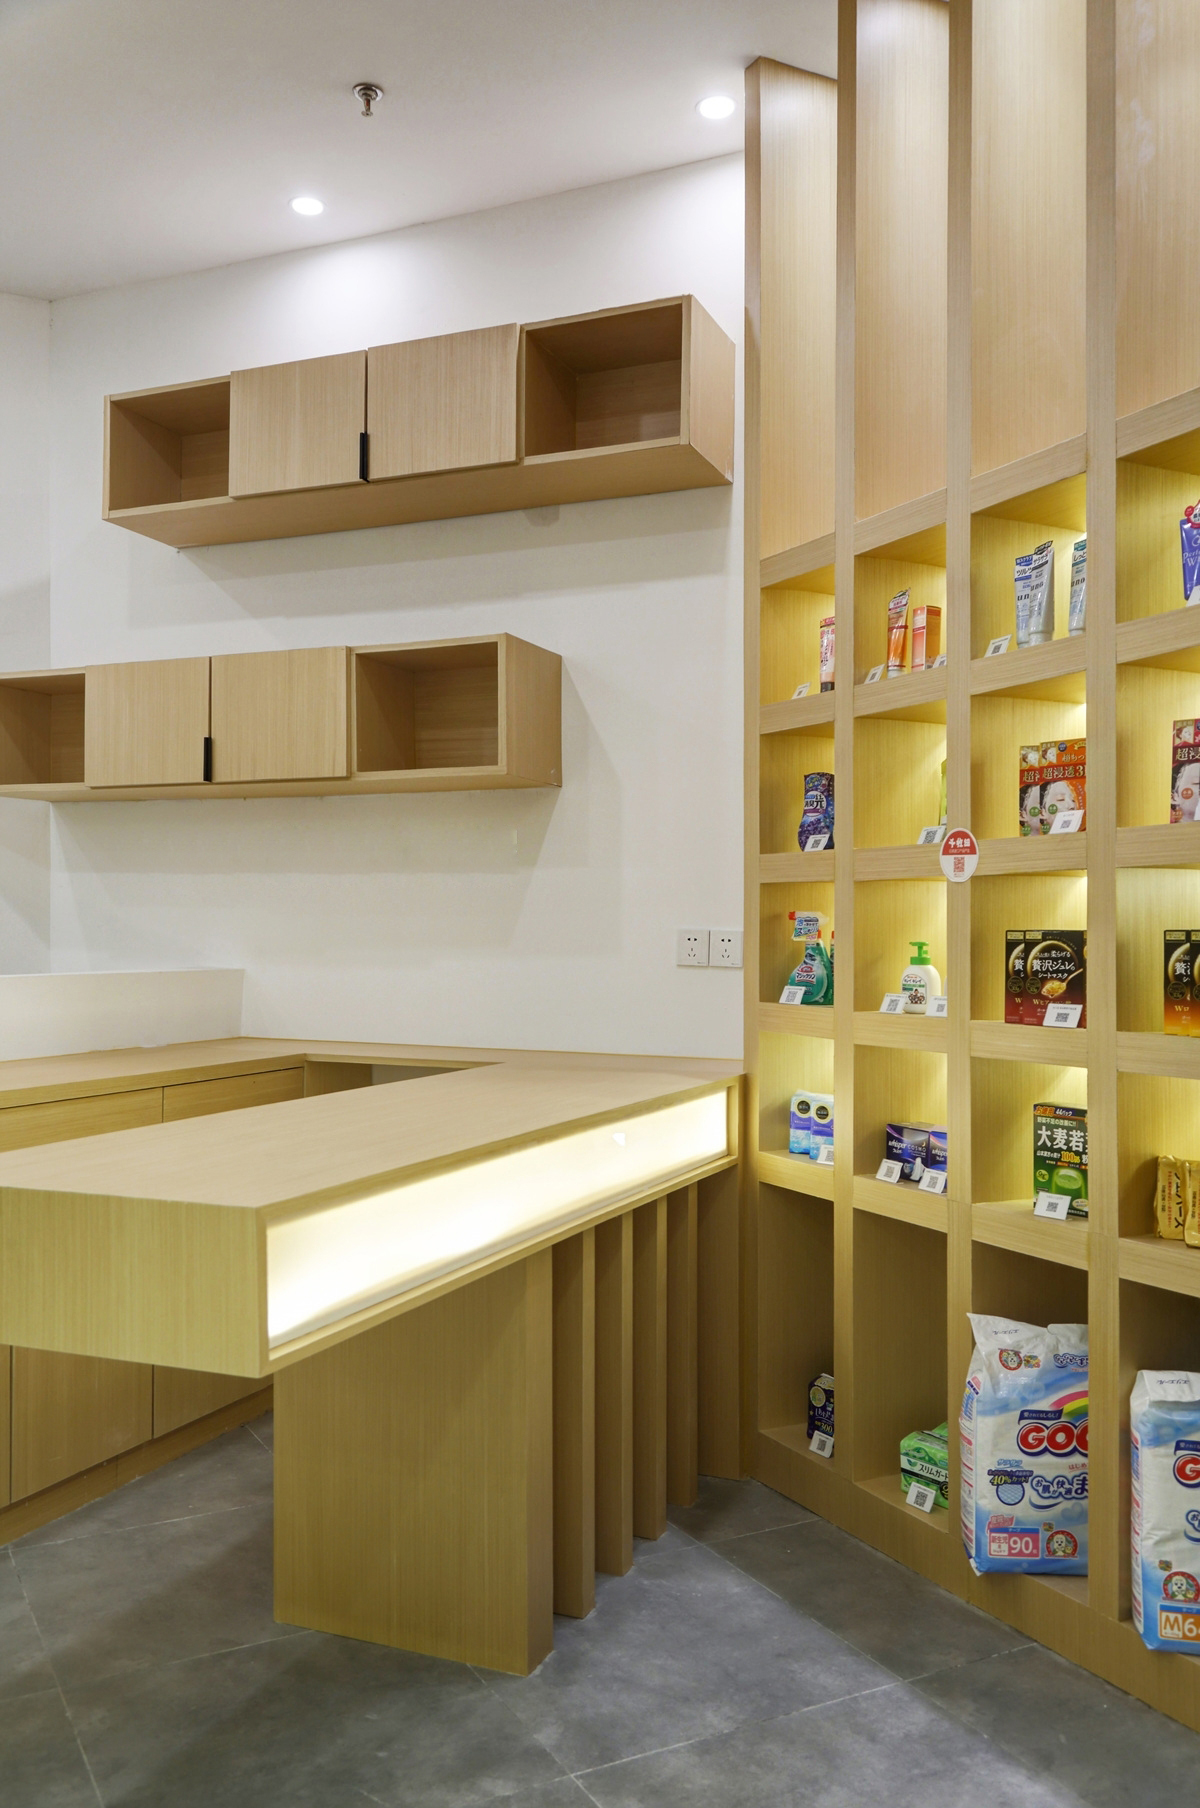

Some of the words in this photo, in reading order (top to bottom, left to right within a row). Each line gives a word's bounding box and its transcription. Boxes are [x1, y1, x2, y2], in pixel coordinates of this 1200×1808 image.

[1071, 577, 1086, 588] uno
[991, 1475, 1012, 1486] 40%
[1009, 1536, 1033, 1554] 90
[1163, 1614, 1181, 1632] M
[1184, 1617, 1200, 1637] 6
